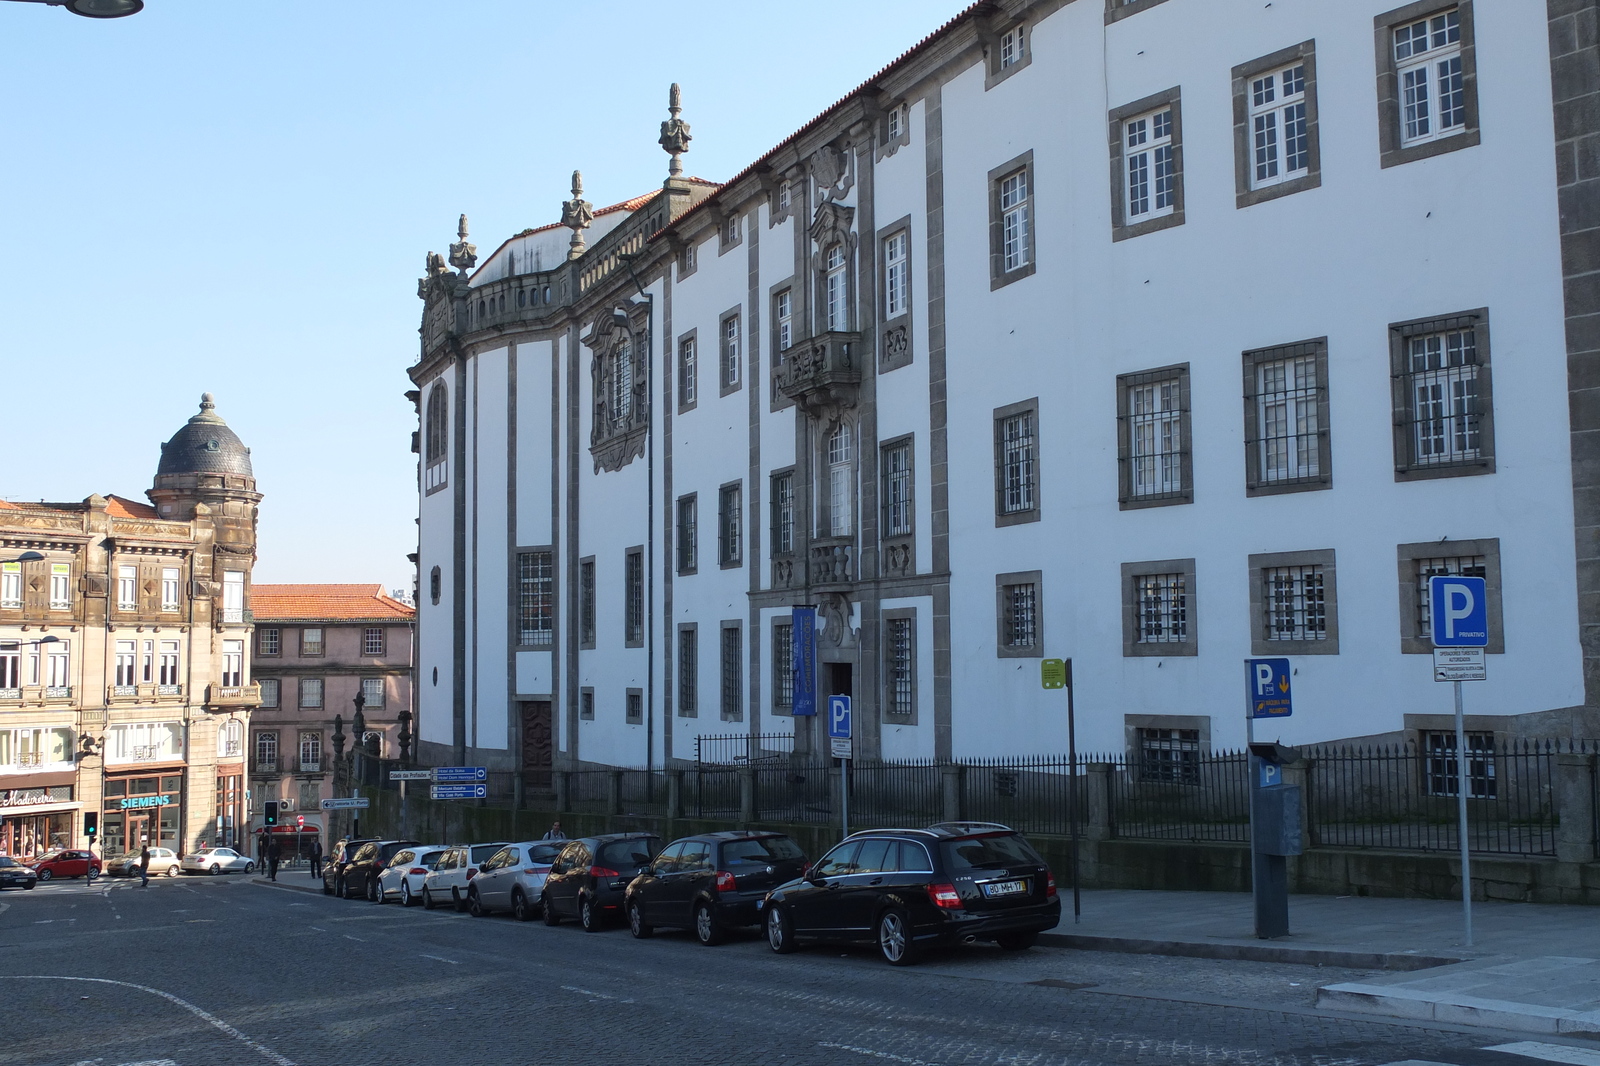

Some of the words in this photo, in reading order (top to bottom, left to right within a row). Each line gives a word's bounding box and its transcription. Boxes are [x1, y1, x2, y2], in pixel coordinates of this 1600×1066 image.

[1443, 583, 1474, 639] P
[804, 615, 812, 694] COMEMORAÇÕES
[1256, 663, 1273, 695] P
[833, 700, 846, 733] P
[1265, 765, 1275, 783] P
[120, 795, 169, 809] SIEMENS
